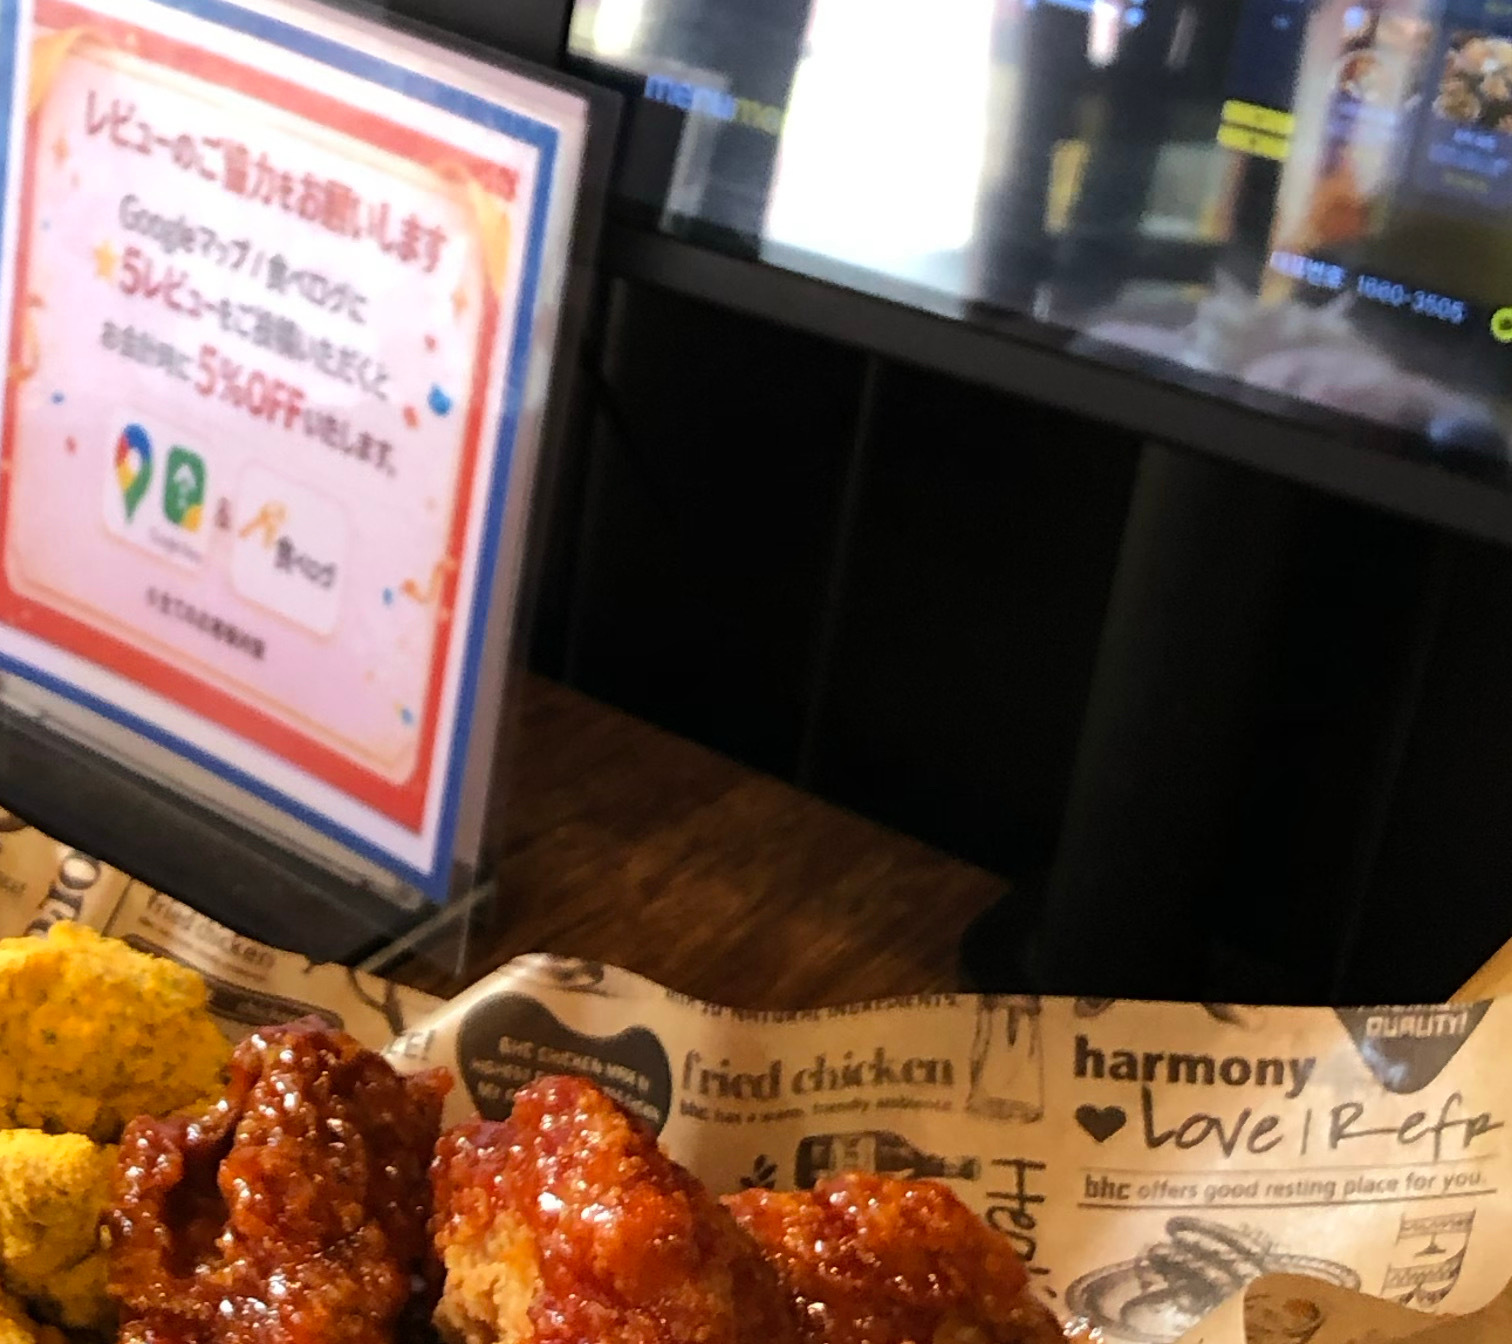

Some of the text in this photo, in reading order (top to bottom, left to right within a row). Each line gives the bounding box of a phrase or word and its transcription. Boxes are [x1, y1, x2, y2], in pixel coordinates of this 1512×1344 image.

[1366, 1012, 1468, 1038] QUALITY!
[683, 1047, 954, 1099] fried chicken
[1074, 1034, 1317, 1099] harmony
[1141, 1085, 1284, 1158] Love
[1084, 1174, 1130, 1201] bhc
[1137, 1178, 1198, 1200] offers
[1204, 1178, 1259, 1203] good
[1265, 1177, 1336, 1202] resting
[1343, 1174, 1399, 1201] place
[1404, 1171, 1436, 1193] for
